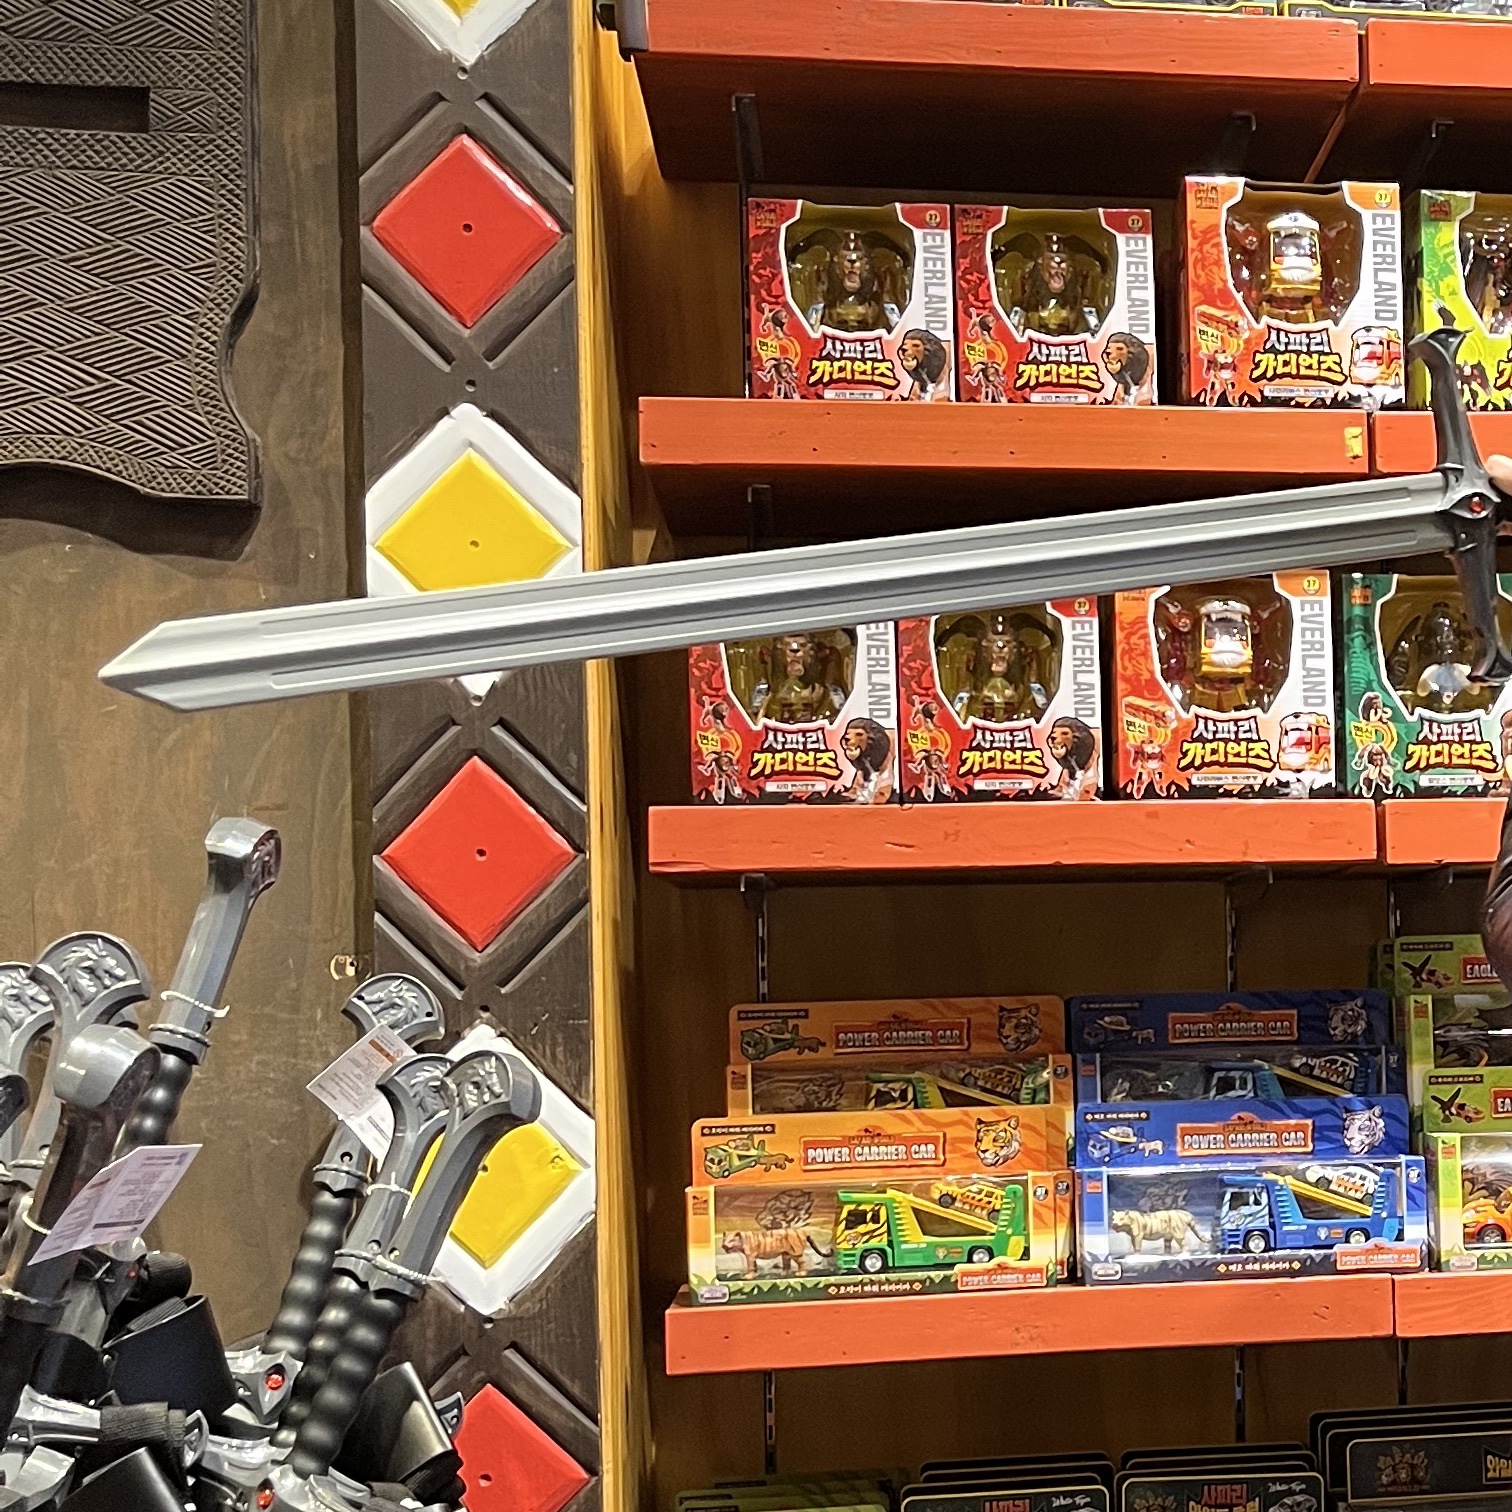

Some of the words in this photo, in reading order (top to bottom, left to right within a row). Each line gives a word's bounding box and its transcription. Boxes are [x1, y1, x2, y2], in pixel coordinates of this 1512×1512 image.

[1371, 212, 1399, 323] EVERLAND
[922, 230, 946, 332] EVERLAND
[1125, 236, 1150, 334] EVERLAND
[1198, 328, 1220, 343] 변신
[1265, 330, 1329, 354] 사파리
[822, 338, 884, 359] 사파리
[1028, 341, 1087, 363] 사파리
[809, 360, 899, 386] 가디언즈
[1015, 363, 1103, 389] 가디언즈
[1253, 352, 1347, 382] 가디언즈
[1299, 601, 1326, 709] EVERLAND
[1072, 618, 1096, 721] EVERLAND
[1125, 719, 1149, 734] 변신
[1193, 718, 1258, 741] 사파리
[1352, 722, 1375, 739] 변신
[1418, 718, 1482, 742] 사파리
[698, 732, 719, 746] 변신
[763, 730, 825, 750] 사파리
[909, 732, 929, 746] 변신
[972, 729, 1033, 750] 사파리
[750, 750, 842, 776] 가디언즈
[959, 749, 1048, 776] 가디언즈
[1181, 740, 1275, 770] 가디언즈
[1406, 741, 1498, 770] 가디언즈
[838, 1033, 879, 1047] POWER
[883, 1031, 933, 1046] CARRIER
[937, 1030, 960, 1044] CAR
[1175, 1023, 1214, 1038] POWER
[1218, 1022, 1265, 1037] CARRIER
[1268, 1021, 1291, 1035] CAR
[1183, 1135, 1225, 1150] POWER
[1229, 1133, 1278, 1148] CARRIER
[1281, 1131, 1304, 1146] CAR
[806, 1148, 850, 1164] POWER
[854, 1145, 907, 1162] CARRIER
[911, 1144, 936, 1160] CAR
[1201, 1483, 1247, 1504] 사파리
